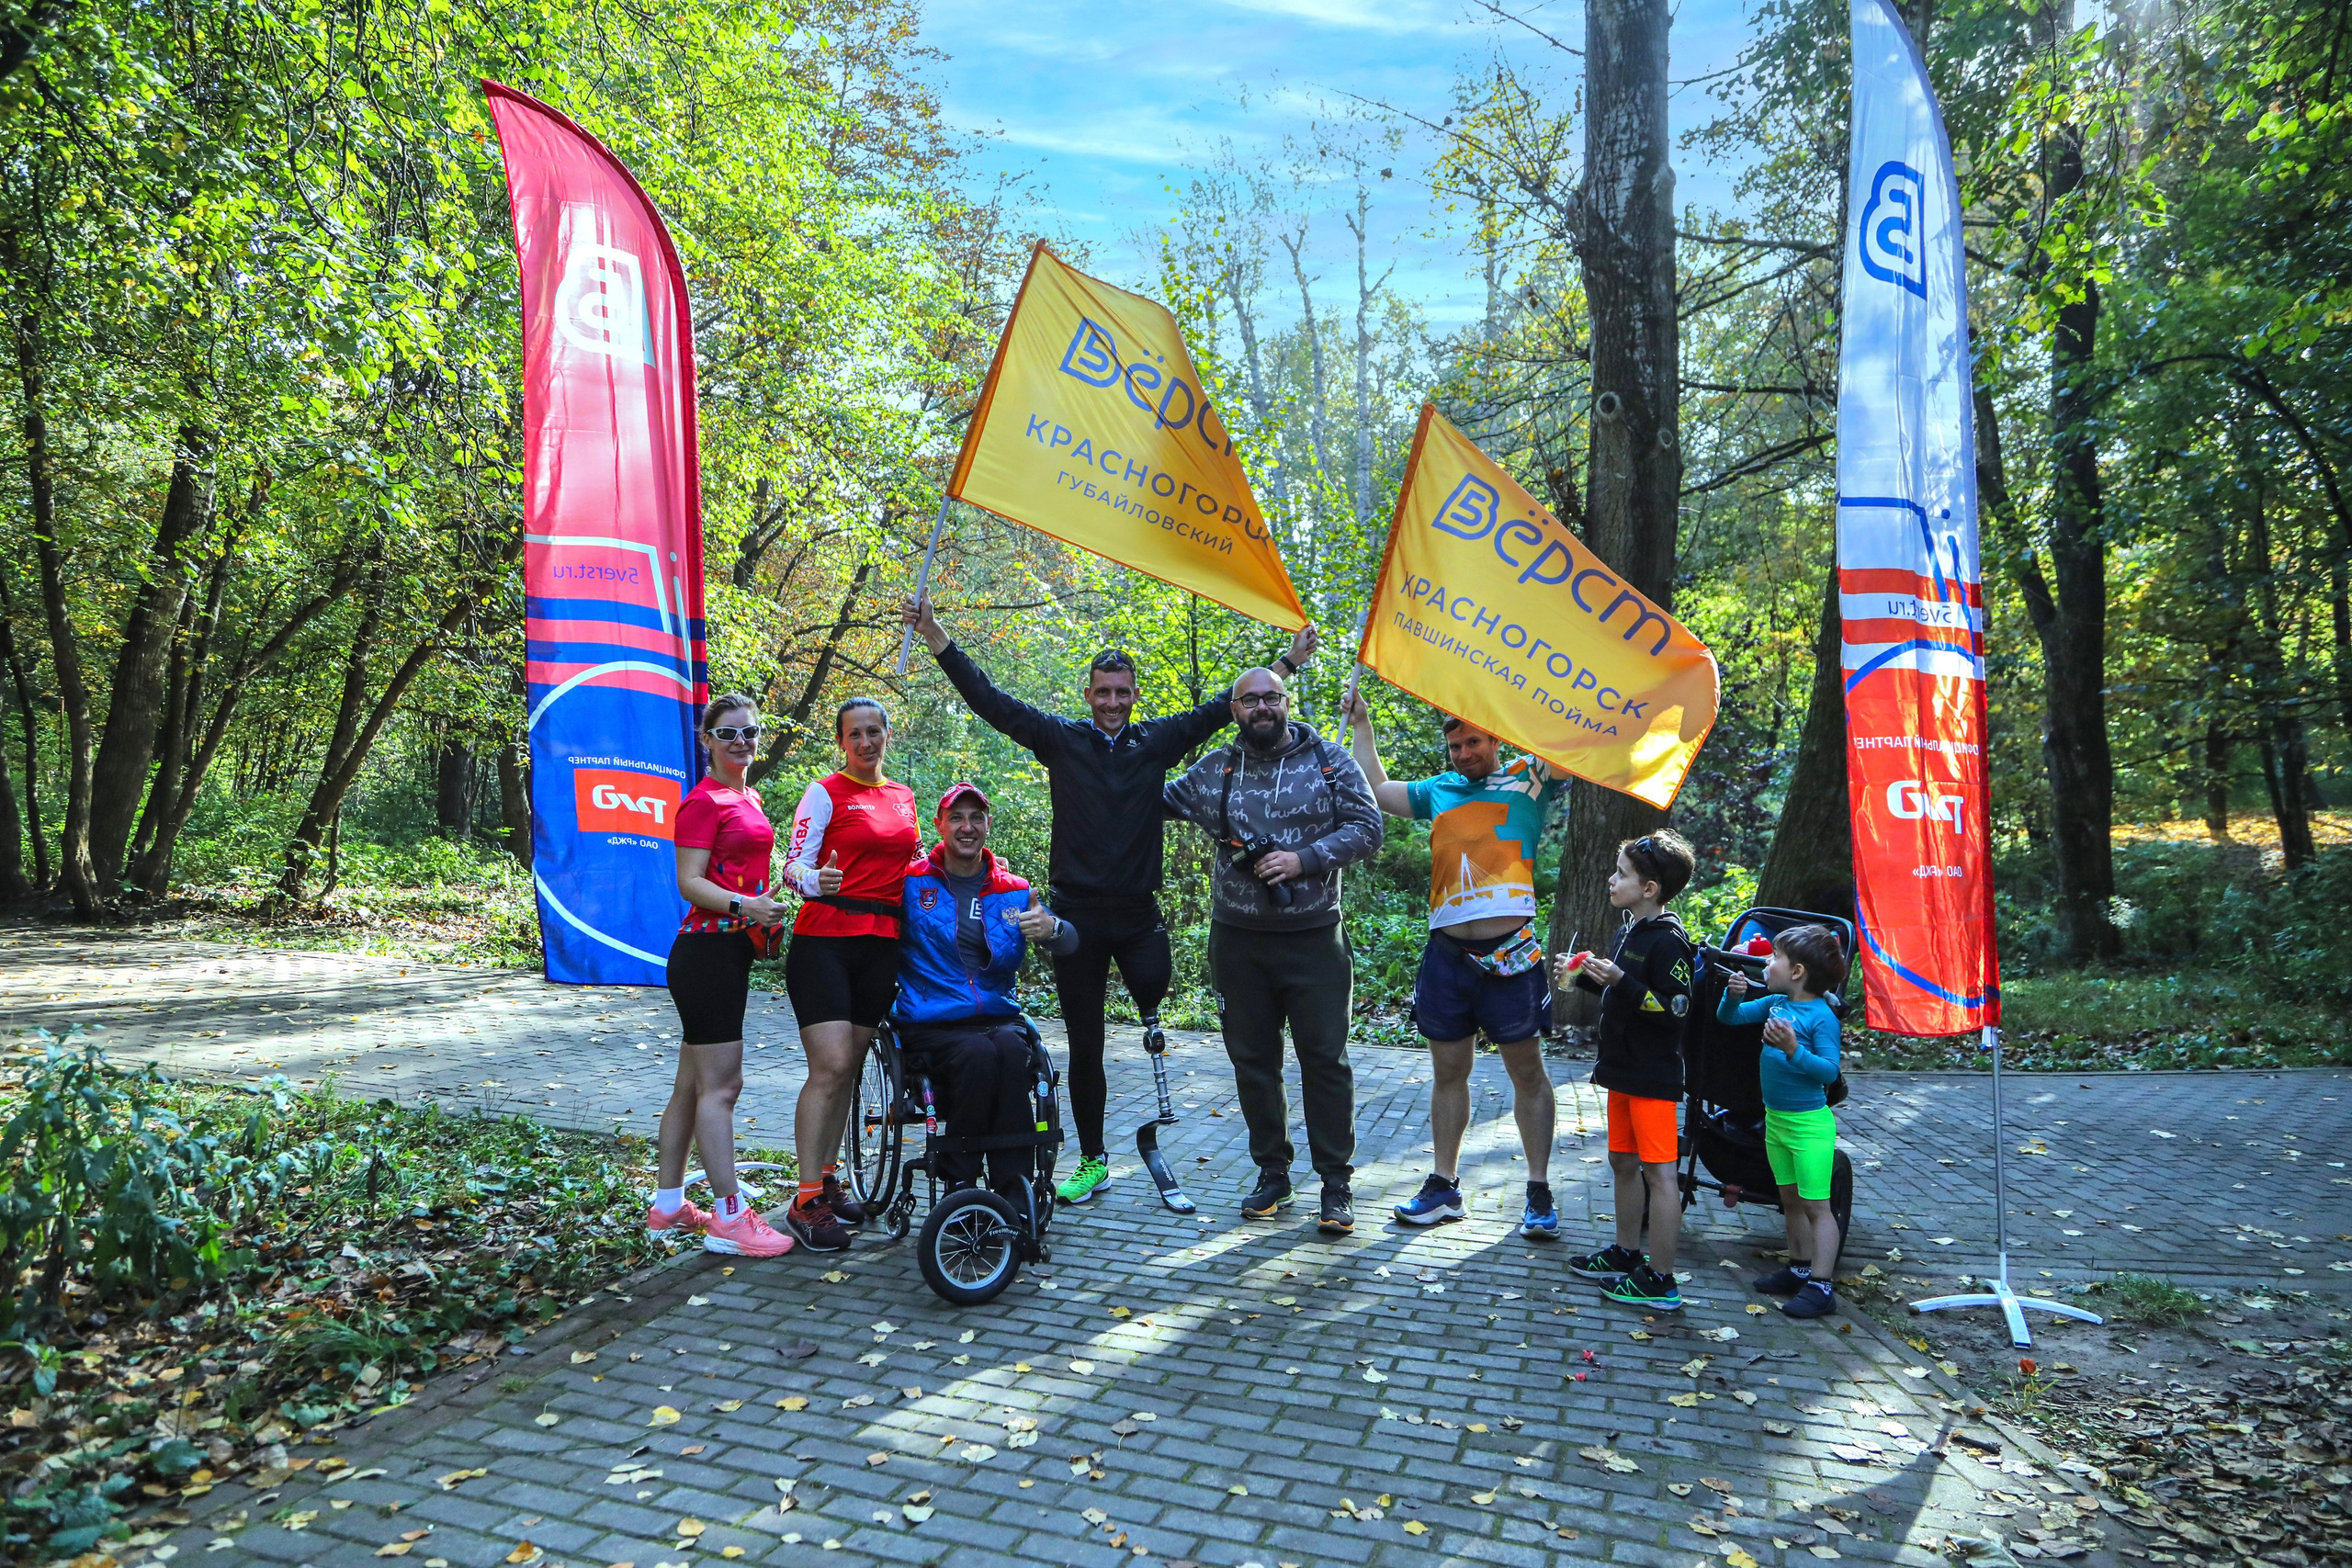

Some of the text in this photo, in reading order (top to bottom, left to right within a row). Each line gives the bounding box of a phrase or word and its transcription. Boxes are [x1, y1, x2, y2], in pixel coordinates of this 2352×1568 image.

[1059, 316, 1232, 457] Вёрс
[1057, 470, 1233, 555] ГУБАЙЛОВСКИЙ
[1394, 611, 1618, 737] ПАВШИНСКАЯ ПОЙМА
[1400, 570, 1650, 719] КРАСНОГОРСК
